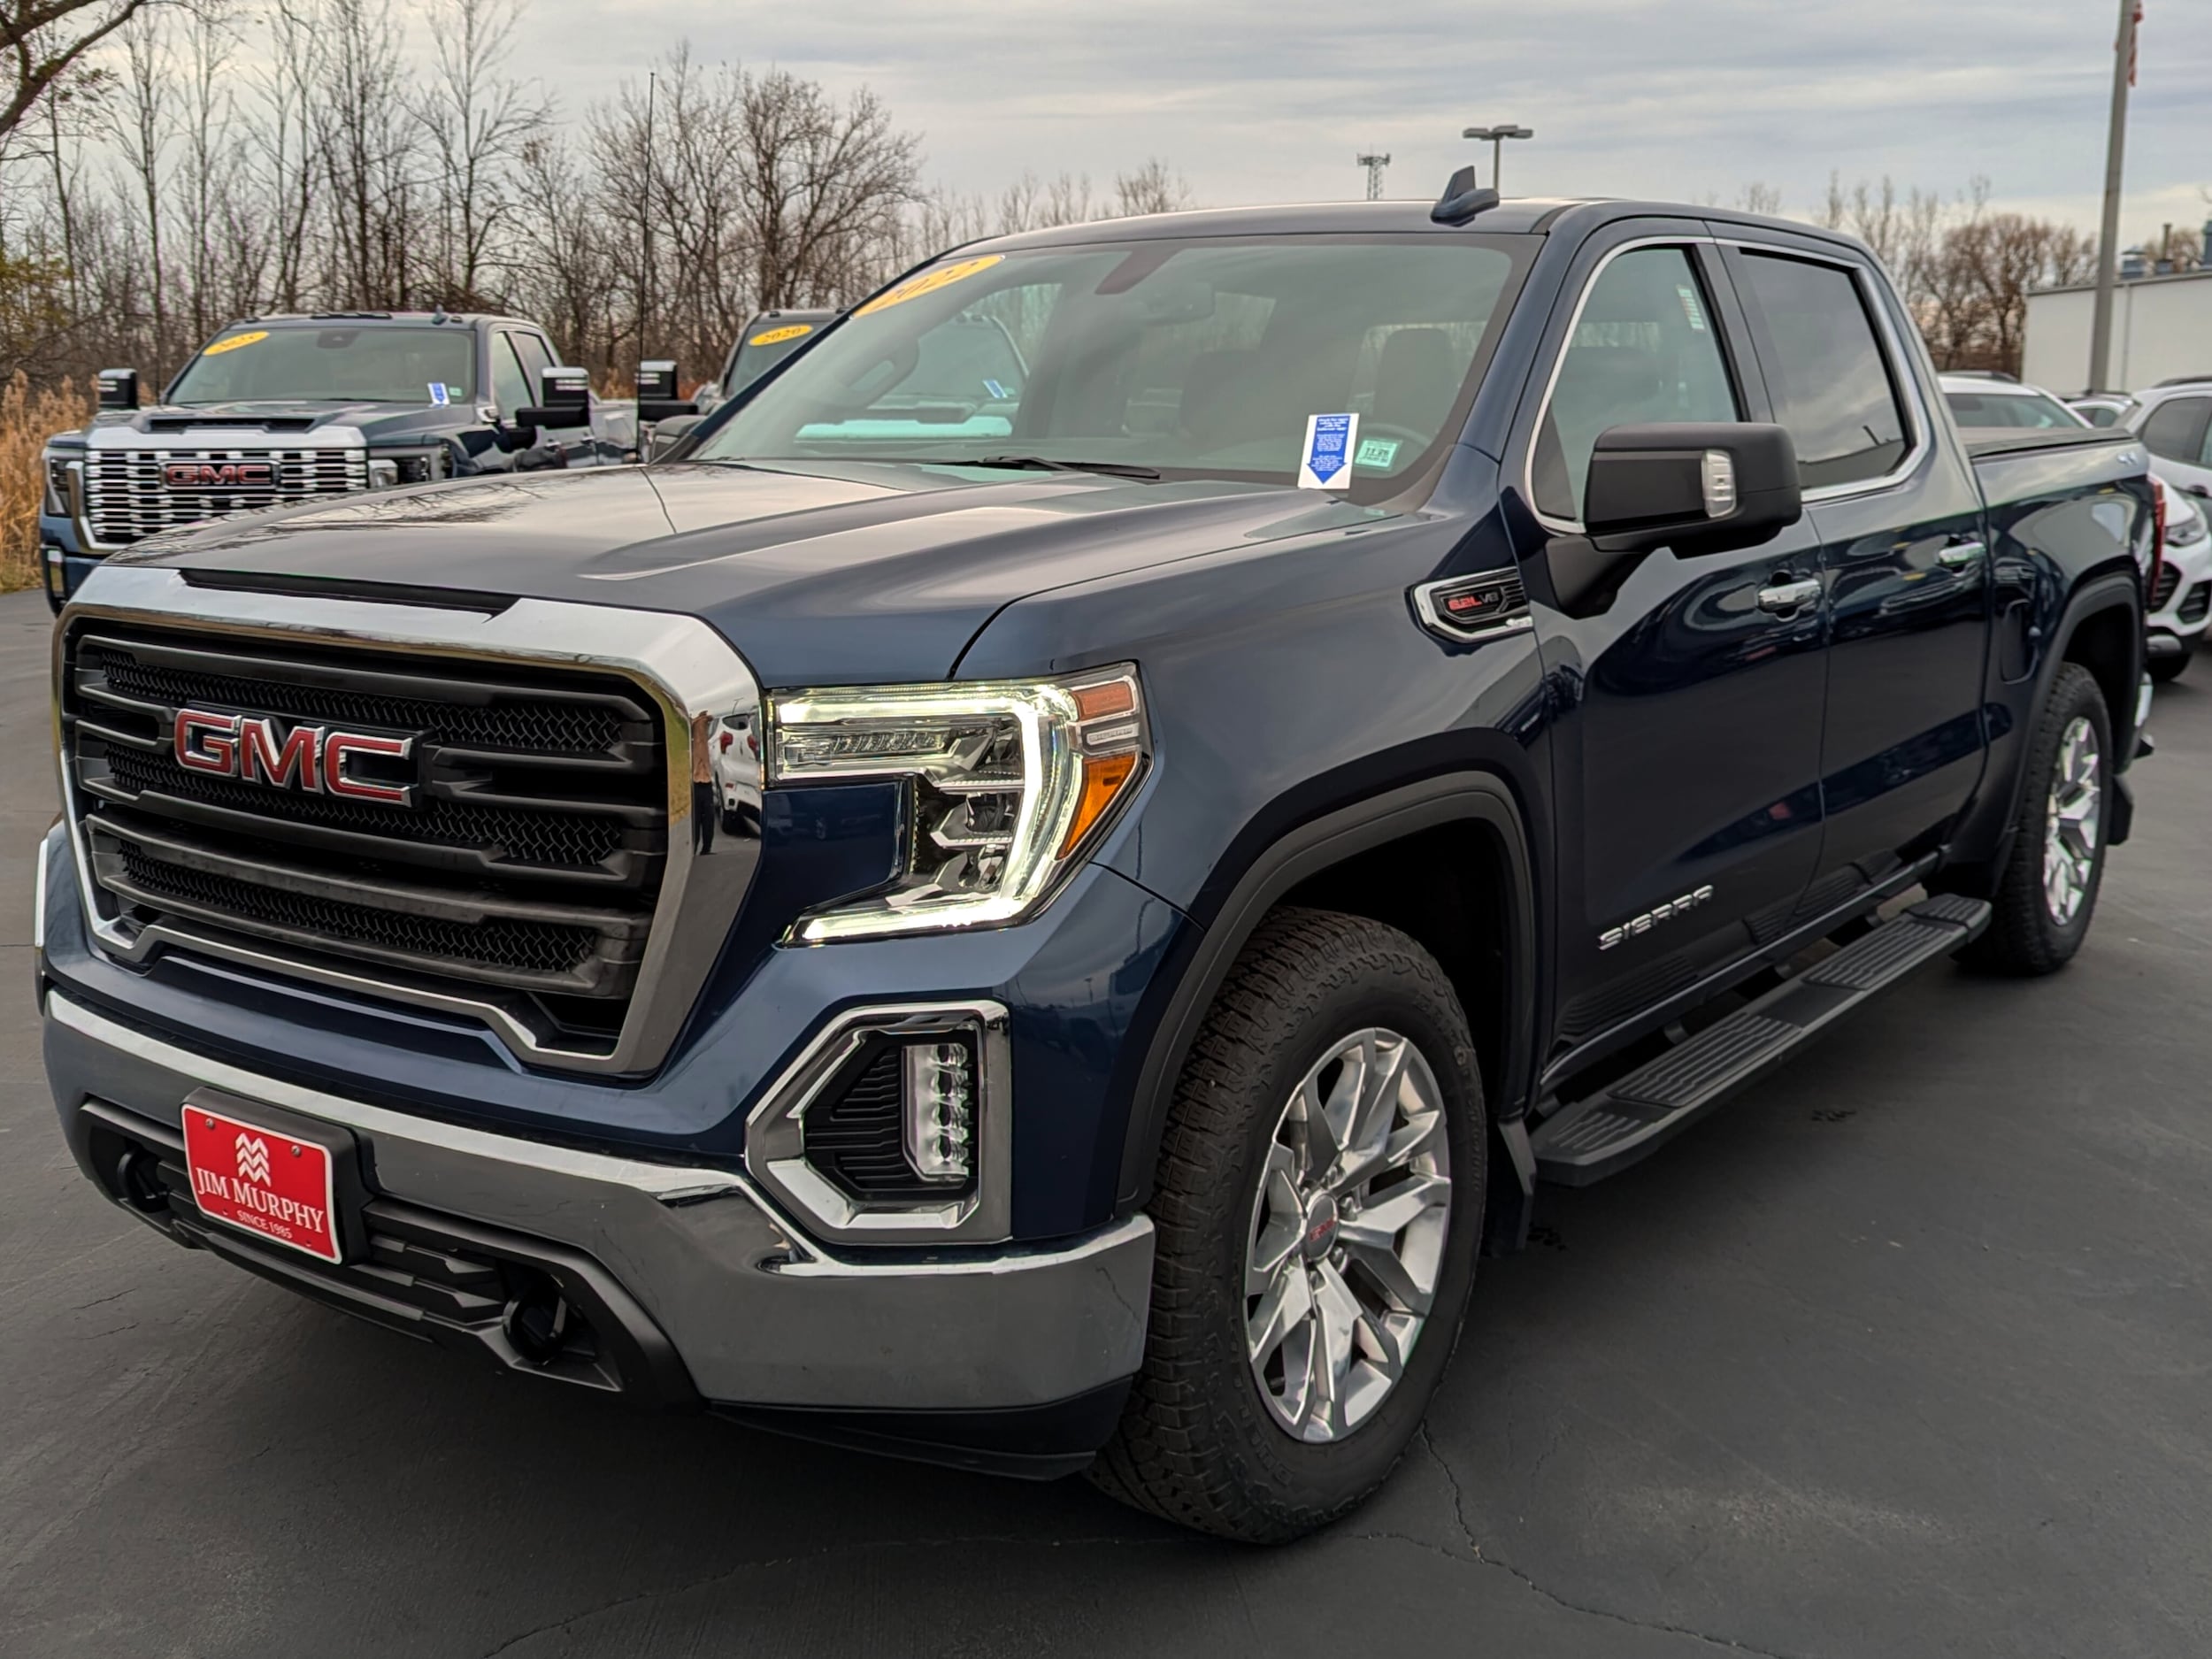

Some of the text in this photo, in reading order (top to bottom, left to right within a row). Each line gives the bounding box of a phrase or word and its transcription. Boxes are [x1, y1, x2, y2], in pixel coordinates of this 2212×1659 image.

[166, 465, 271, 485] GMC
[174, 708, 412, 807] GMC
[1598, 884, 1714, 950] SIERRA
[196, 1167, 325, 1233] JIM MURPHY
[236, 1210, 269, 1231] SINCE
